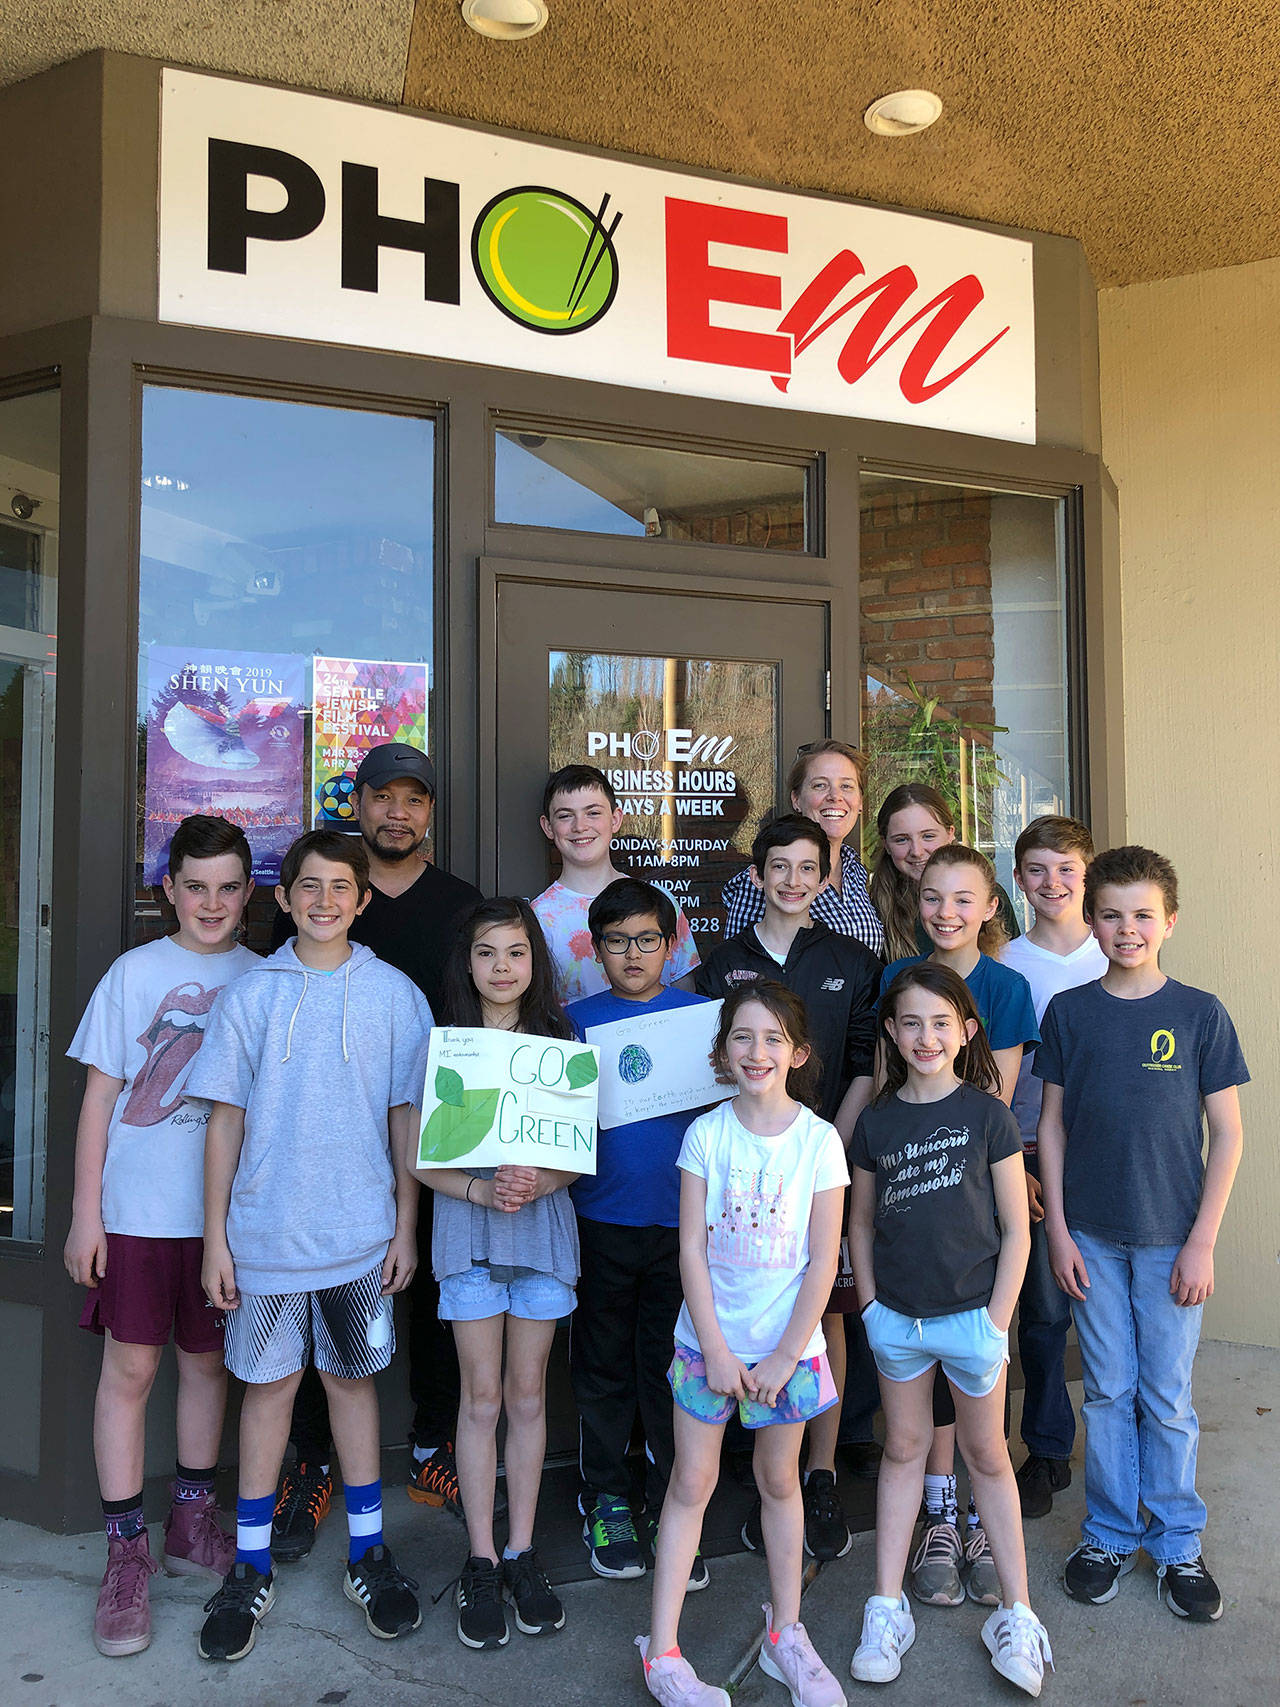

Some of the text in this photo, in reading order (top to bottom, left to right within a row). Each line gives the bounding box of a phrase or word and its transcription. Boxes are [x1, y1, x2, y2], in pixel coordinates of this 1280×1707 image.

[208, 137, 1010, 404] PHO Em
[245, 666, 273, 677] 2019
[169, 674, 285, 695] SHEN YUN
[323, 685, 385, 700] SEATTLE
[323, 697, 377, 711] JEWISH
[323, 710, 357, 723] FILM
[323, 723, 390, 736] FESTIVAL
[322, 748, 346, 757] MAR
[587, 729, 740, 765] PHO Em
[323, 759, 346, 768] APR
[602, 769, 737, 792] USINESS HOURS
[659, 799, 672, 816] A
[676, 799, 725, 816] WEEK
[610, 838, 730, 851] ONDAY-SATURDAY
[627, 854, 700, 867] 11AM-8PM
[689, 917, 720, 933] 828
[510, 1044, 565, 1087] GO
[499, 1091, 593, 1152] GREEN
[904, 1132, 970, 1160] Unicorn
[889, 1152, 949, 1182] ate my
